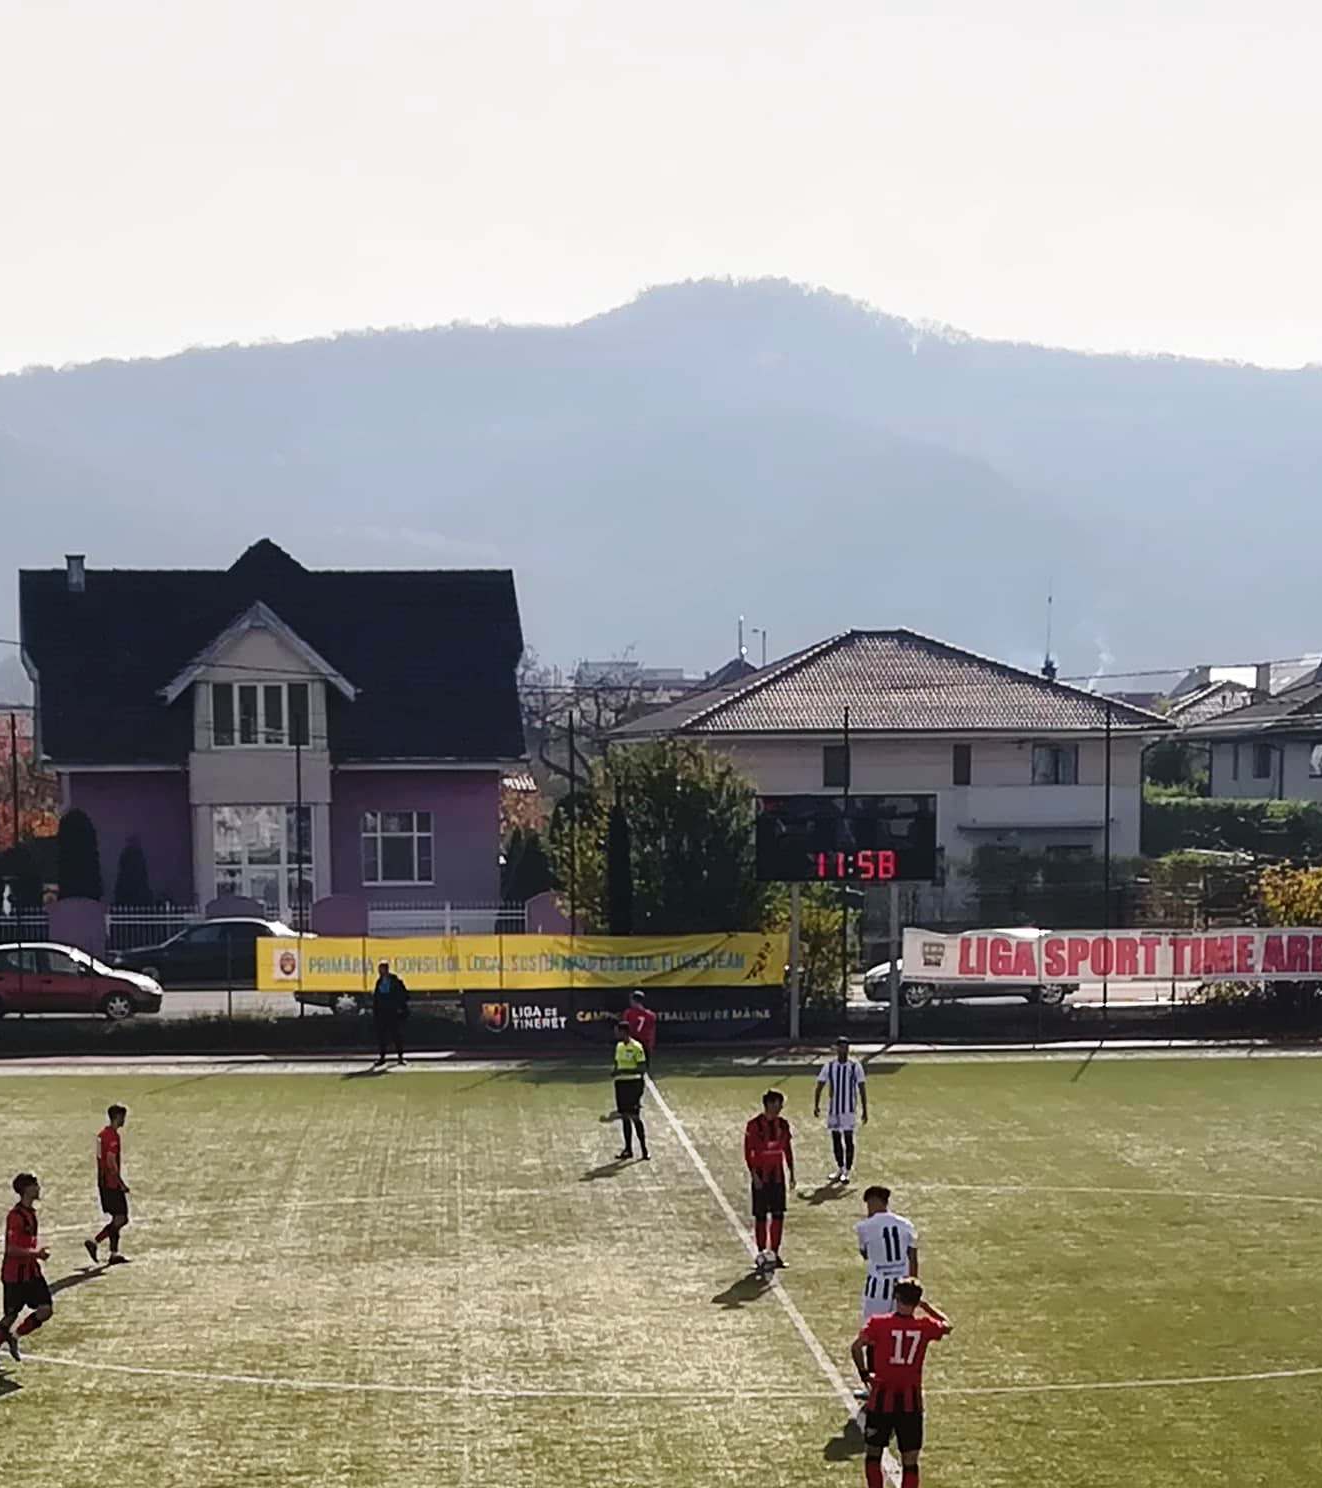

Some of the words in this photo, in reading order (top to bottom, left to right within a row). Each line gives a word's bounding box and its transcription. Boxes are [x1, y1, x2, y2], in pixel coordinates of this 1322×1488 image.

[816, 850, 896, 879] 11:58
[958, 937, 1038, 976] LIGA
[1044, 937, 1162, 976] SPORT
[1168, 934, 1255, 975] TIME
[511, 1006, 542, 1018] LIGA
[512, 1016, 567, 1030] TINERET
[637, 1016, 646, 1032] 7
[883, 1226, 901, 1262] 11
[889, 1330, 921, 1365] 17
